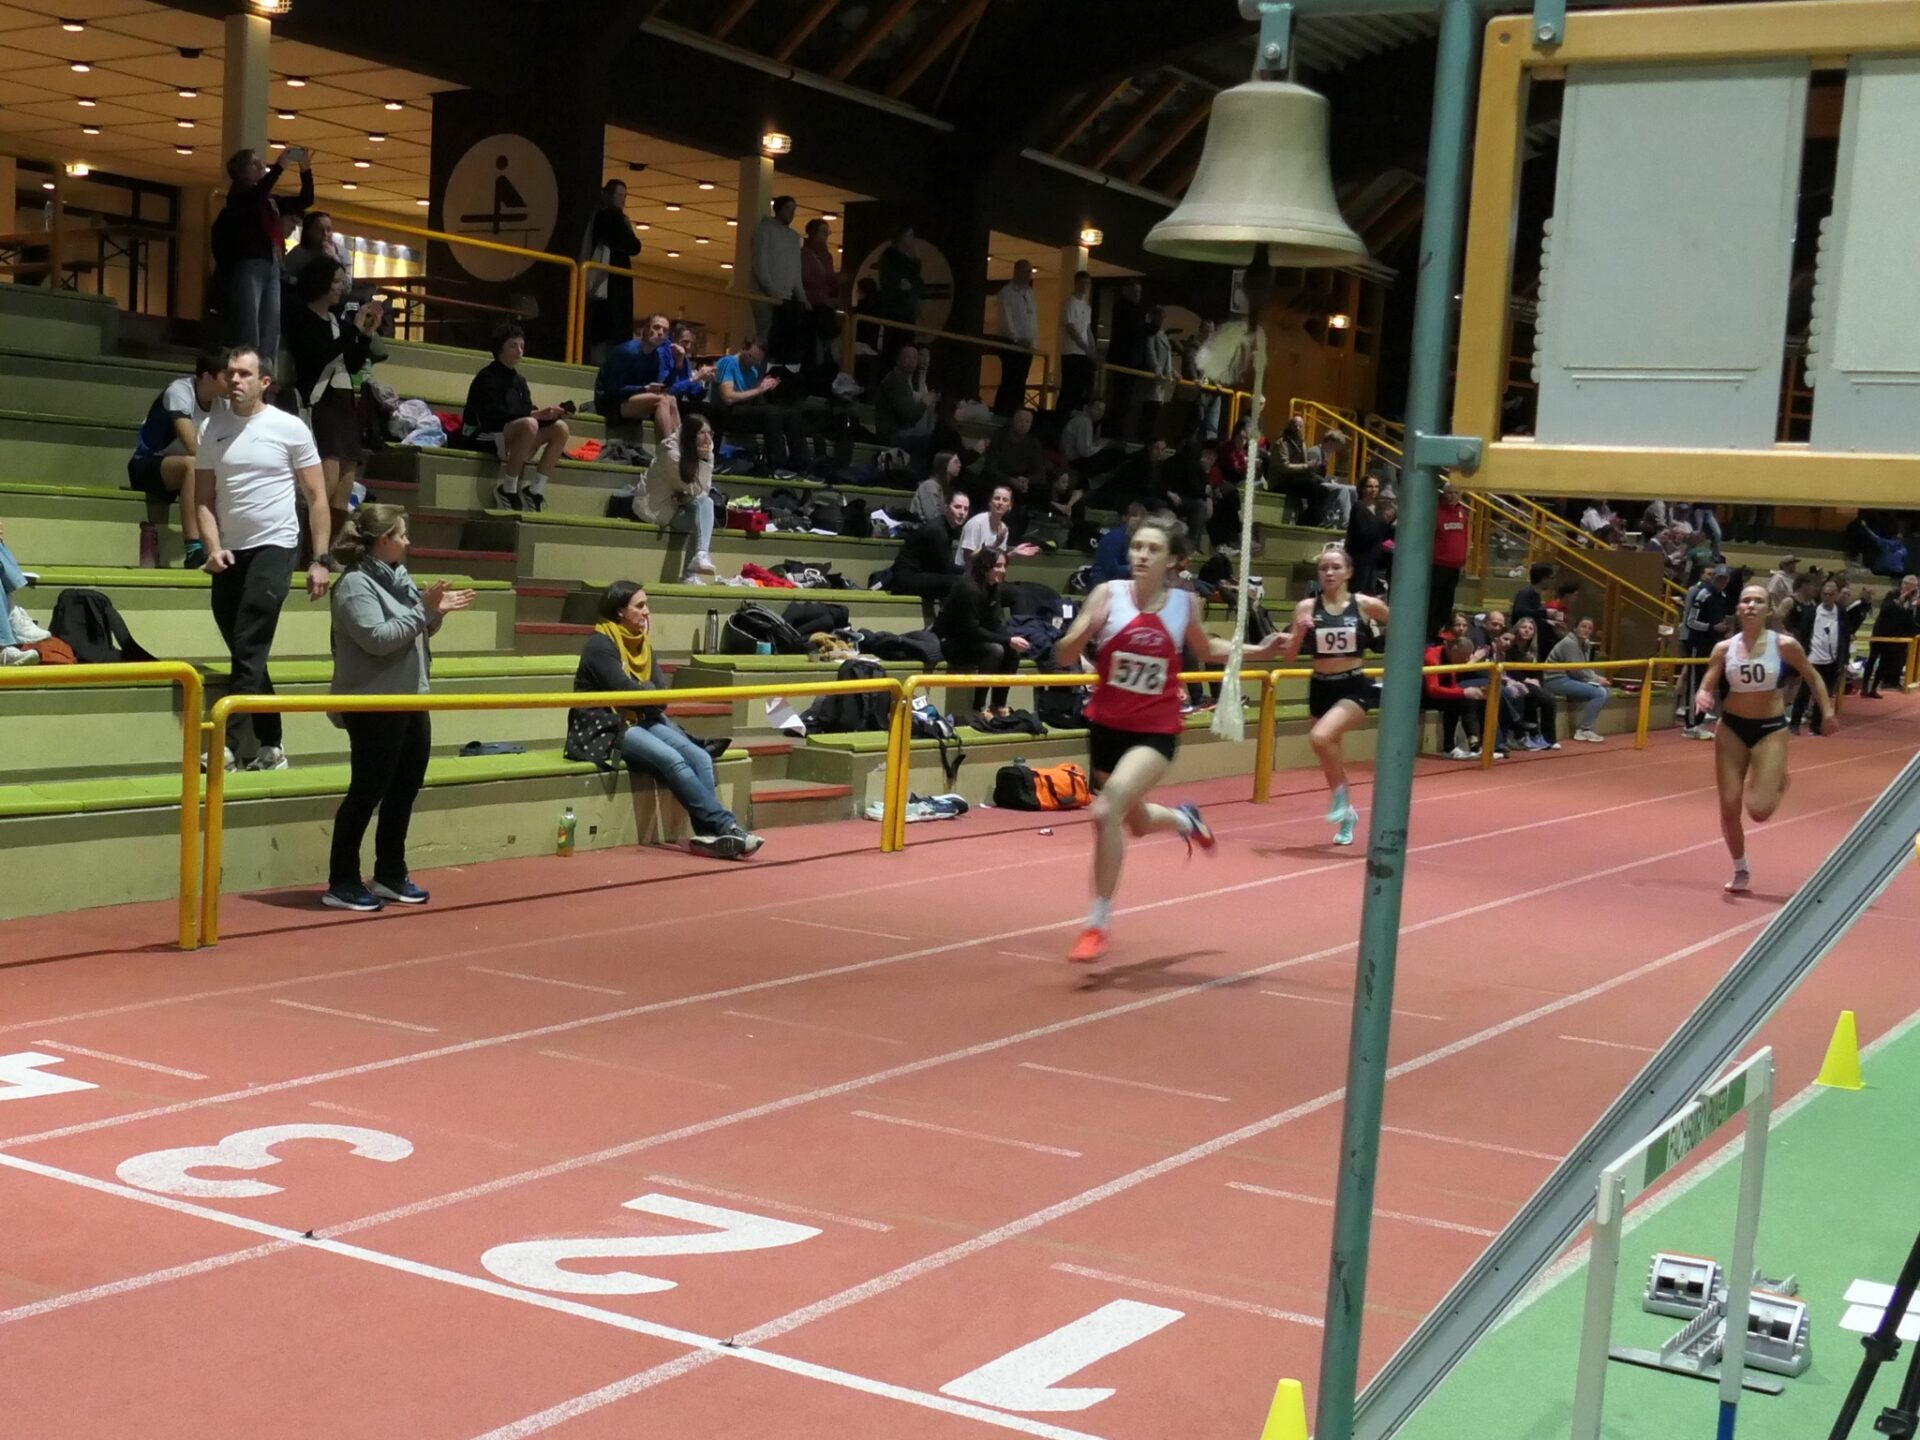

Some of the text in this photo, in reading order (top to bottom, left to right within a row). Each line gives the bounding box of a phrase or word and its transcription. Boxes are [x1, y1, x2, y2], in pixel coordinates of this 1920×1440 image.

[1325, 632, 1348, 651] 95
[1740, 663, 1765, 684] 50
[116, 1123, 414, 1199] 3
[481, 1193, 821, 1295] 2
[939, 1298, 1186, 1413] 1
